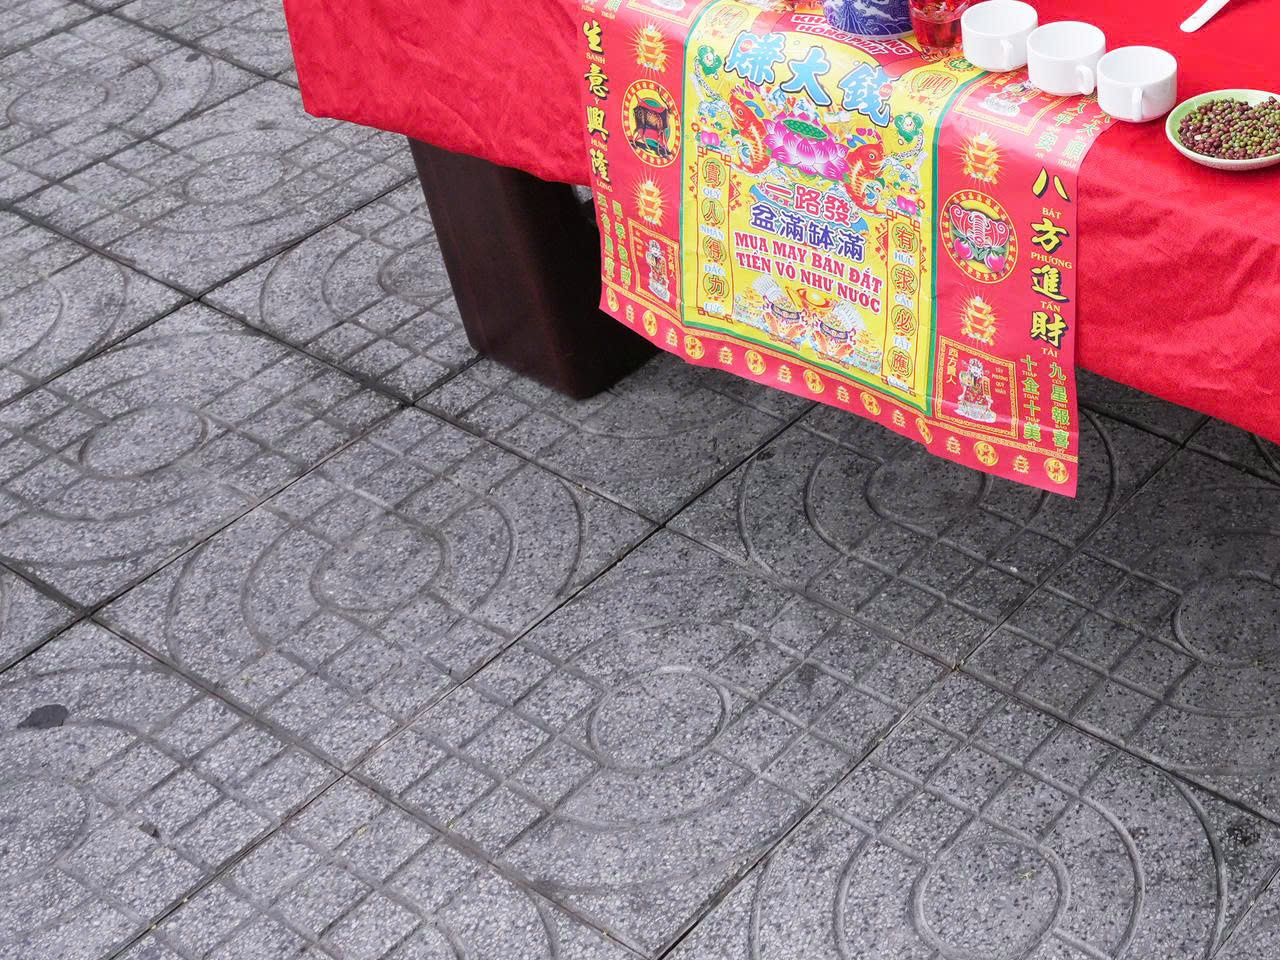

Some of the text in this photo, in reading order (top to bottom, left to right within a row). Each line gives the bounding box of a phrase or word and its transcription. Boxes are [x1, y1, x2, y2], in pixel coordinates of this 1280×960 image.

[1042, 207, 1062, 220] BÁT
[734, 232, 883, 294] MUA MAY BÁN ĐẮT
[1031, 166, 1072, 349] 八方進財
[1031, 252, 1073, 270] PHƯƠNG
[775, 261, 797, 280] VÔ
[800, 268, 834, 292] NHƯ
[837, 282, 881, 313] NƯỚC
[1041, 348, 1058, 359] TÀI
